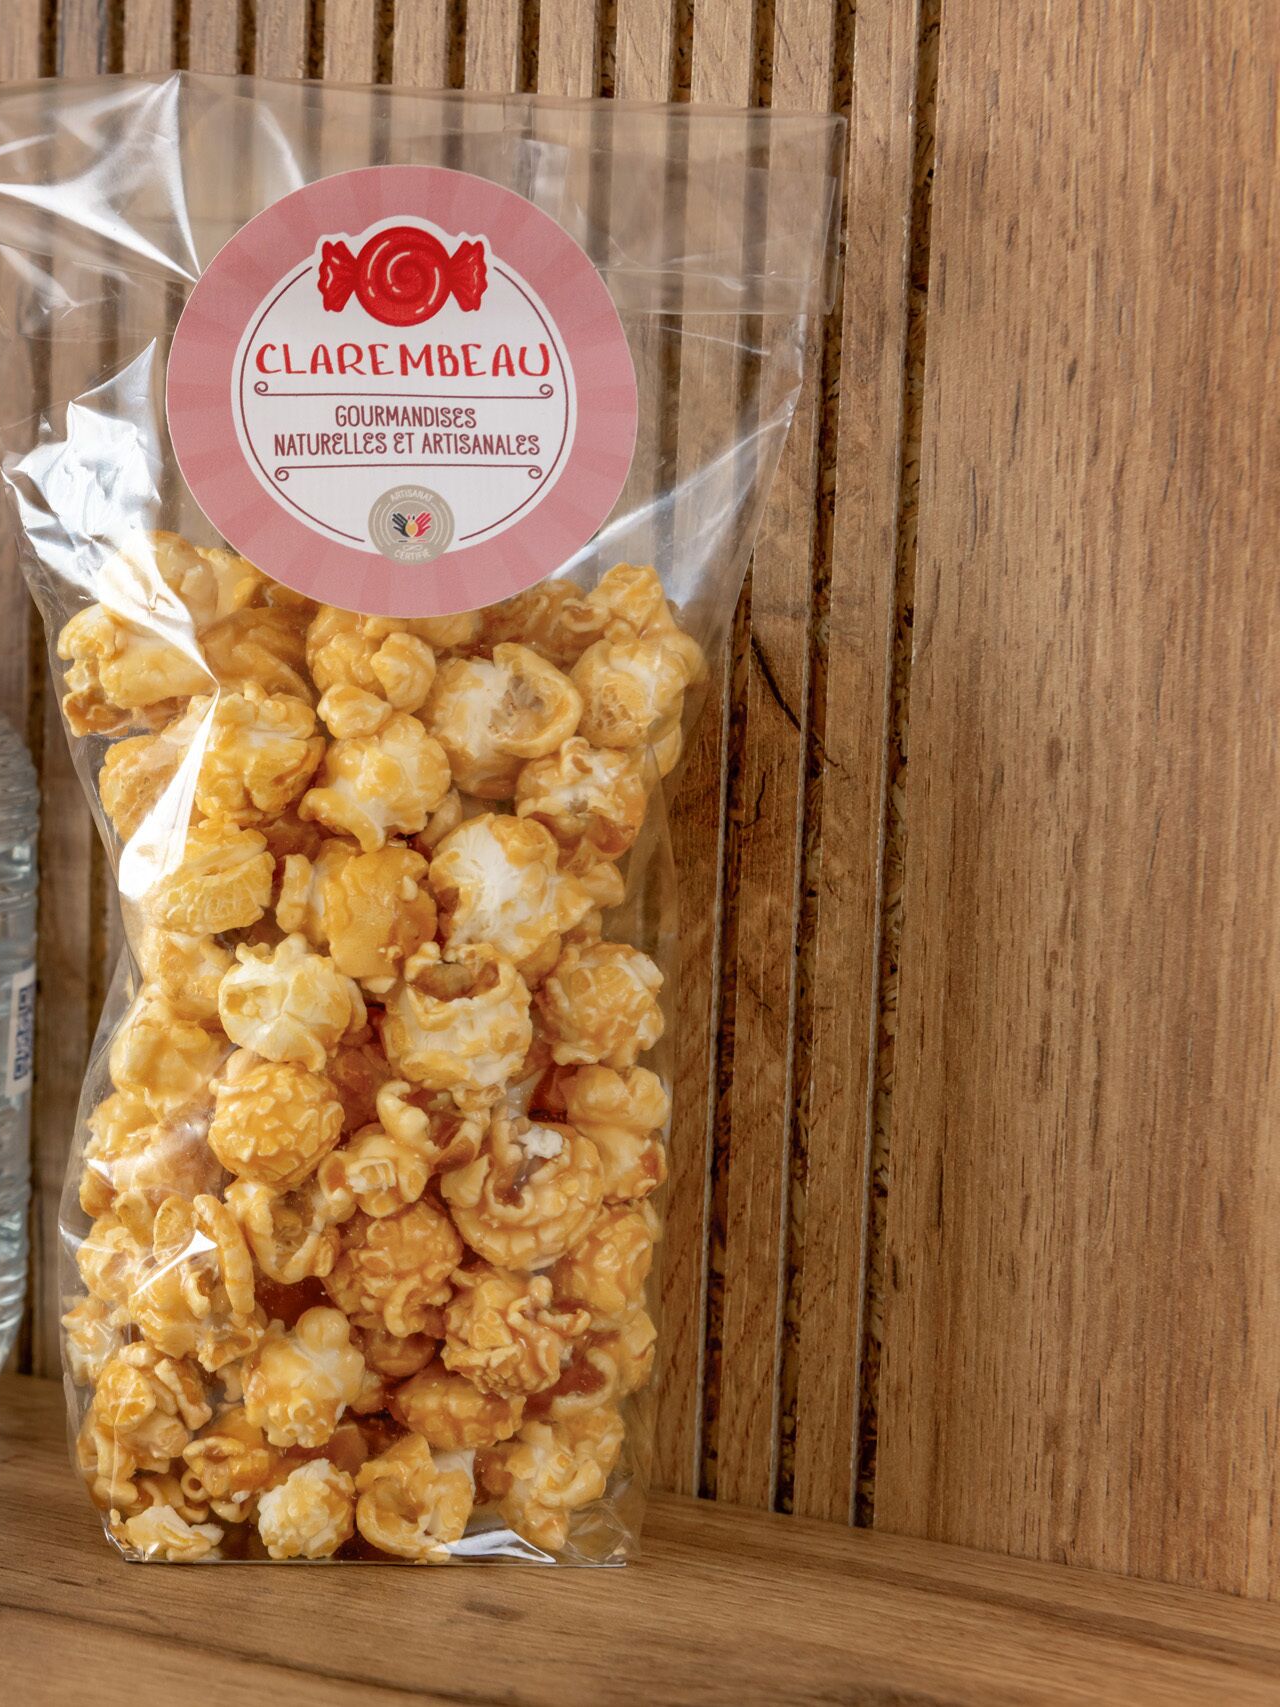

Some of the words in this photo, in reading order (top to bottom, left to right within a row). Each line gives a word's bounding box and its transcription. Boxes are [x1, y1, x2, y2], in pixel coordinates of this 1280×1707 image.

[255, 343, 551, 377] CLAREMBEAU
[335, 405, 477, 429] GOURMANDISES
[274, 432, 388, 456] NATURELLES
[393, 432, 416, 455] ET
[422, 432, 541, 456] ARTISANALES
